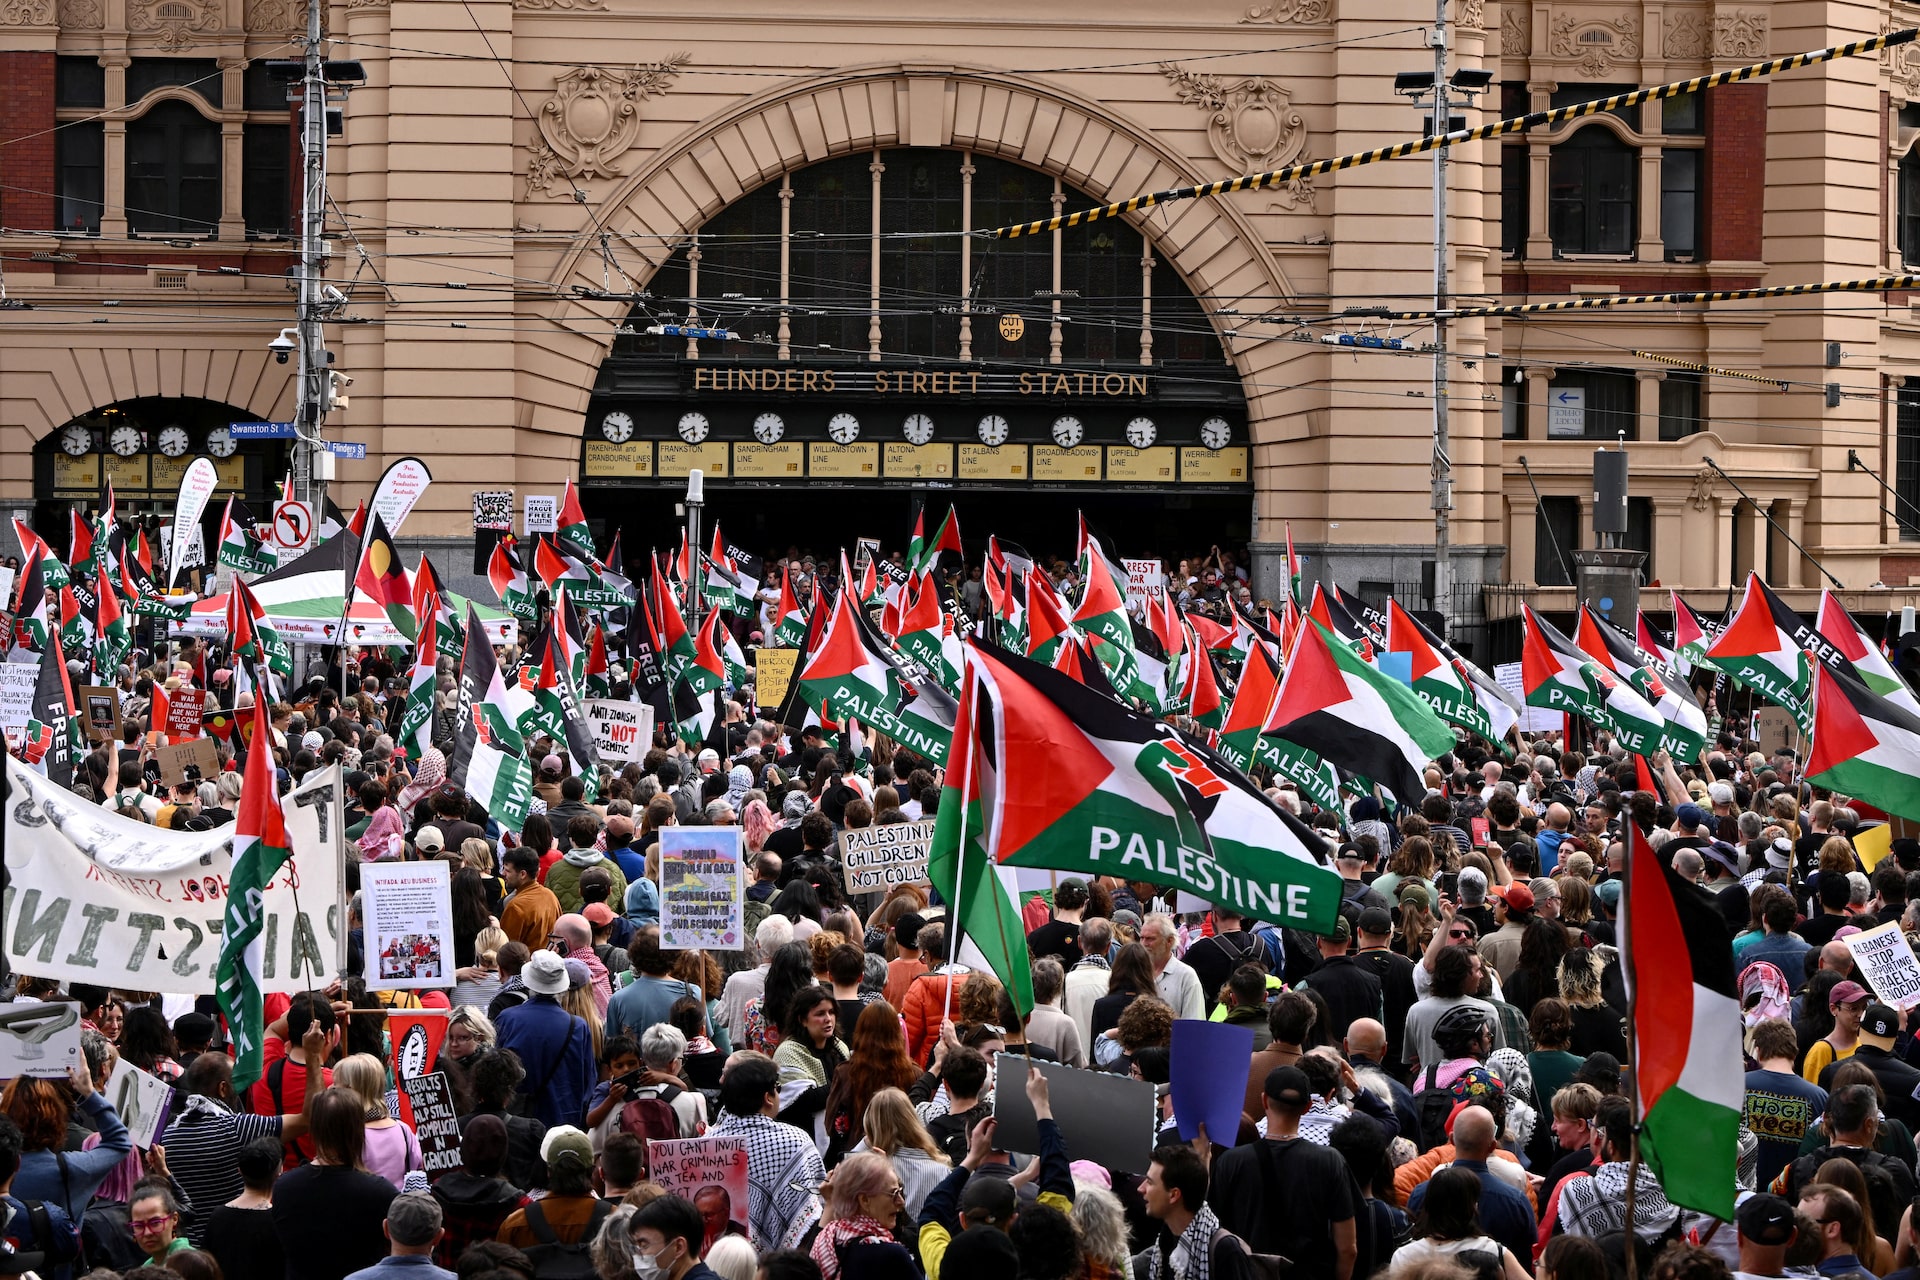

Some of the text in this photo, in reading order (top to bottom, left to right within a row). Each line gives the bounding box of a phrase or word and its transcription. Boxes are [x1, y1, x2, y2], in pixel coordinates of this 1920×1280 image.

[1001, 317, 1019, 328] CUT
[1002, 328, 1022, 339] OFF
[694, 368, 1147, 396] FLINDERS STREET STATION
[232, 424, 279, 433] Swanston St
[333, 443, 364, 453] Flinders St
[588, 444, 622, 452] PAKENHAM
[660, 445, 702, 453] FRANKSTON
[737, 445, 789, 453] SANDRINGHAM
[1036, 449, 1097, 457] BROADMEADOWS
[737, 455, 752, 463] LINE
[476, 495, 509, 507] HERZOG
[480, 504, 505, 516] WAR
[476, 515, 509, 524] CRIMINAL
[221, 551, 275, 574] PALESTIN
[727, 545, 752, 565] FREE
[879, 560, 908, 581] FREE
[1127, 562, 1155, 574] RREST
[72, 584, 95, 608] FREE
[944, 599, 976, 633] FREE
[284, 624, 314, 632] Australia
[1794, 625, 1844, 669] FREE
[639, 642, 662, 685] FREE
[759, 657, 794, 666] HERZOG
[1634, 646, 1677, 682] FREE
[555, 670, 580, 720] FREE
[171, 701, 203, 711] CRIMINALS
[589, 704, 636, 724] ANTI-ZIONISM
[169, 716, 200, 725] WELCOME
[175, 723, 190, 731] HERE
[833, 685, 945, 759] PALESTINE
[48, 702, 67, 764] FREE
[601, 722, 637, 743] IS NOT
[682, 849, 716, 859] REBUILD
[847, 845, 924, 867] CHILDREN
[665, 864, 735, 874] SCHOOLS IN GAZA
[1089, 825, 1310, 919] PALESTINE
[852, 871, 882, 887] NOT
[711, 891, 732, 902] GAZA
[671, 905, 729, 915] SOLIDARITY IN
[672, 919, 728, 930] OUR SCHOOLS
[1853, 932, 1899, 955] ALBANESE
[1867, 948, 1894, 967] STOP
[1865, 955, 1912, 978] SUPPORTING
[1870, 965, 1918, 990] ISRAEL'S
[406, 1076, 441, 1095] RESULTS
[410, 1091, 438, 1108] ARE IN:
[414, 1105, 452, 1123] ALP STILL
[416, 1118, 457, 1141] COMPLICIT
[435, 1137, 445, 1150] IN
[653, 1139, 745, 1159] YOU CANT INVITE
[423, 1148, 464, 1171] GENOCIDE
[652, 1153, 740, 1177] WAR CRIMINALS
[675, 1171, 724, 1183] TEA AND
